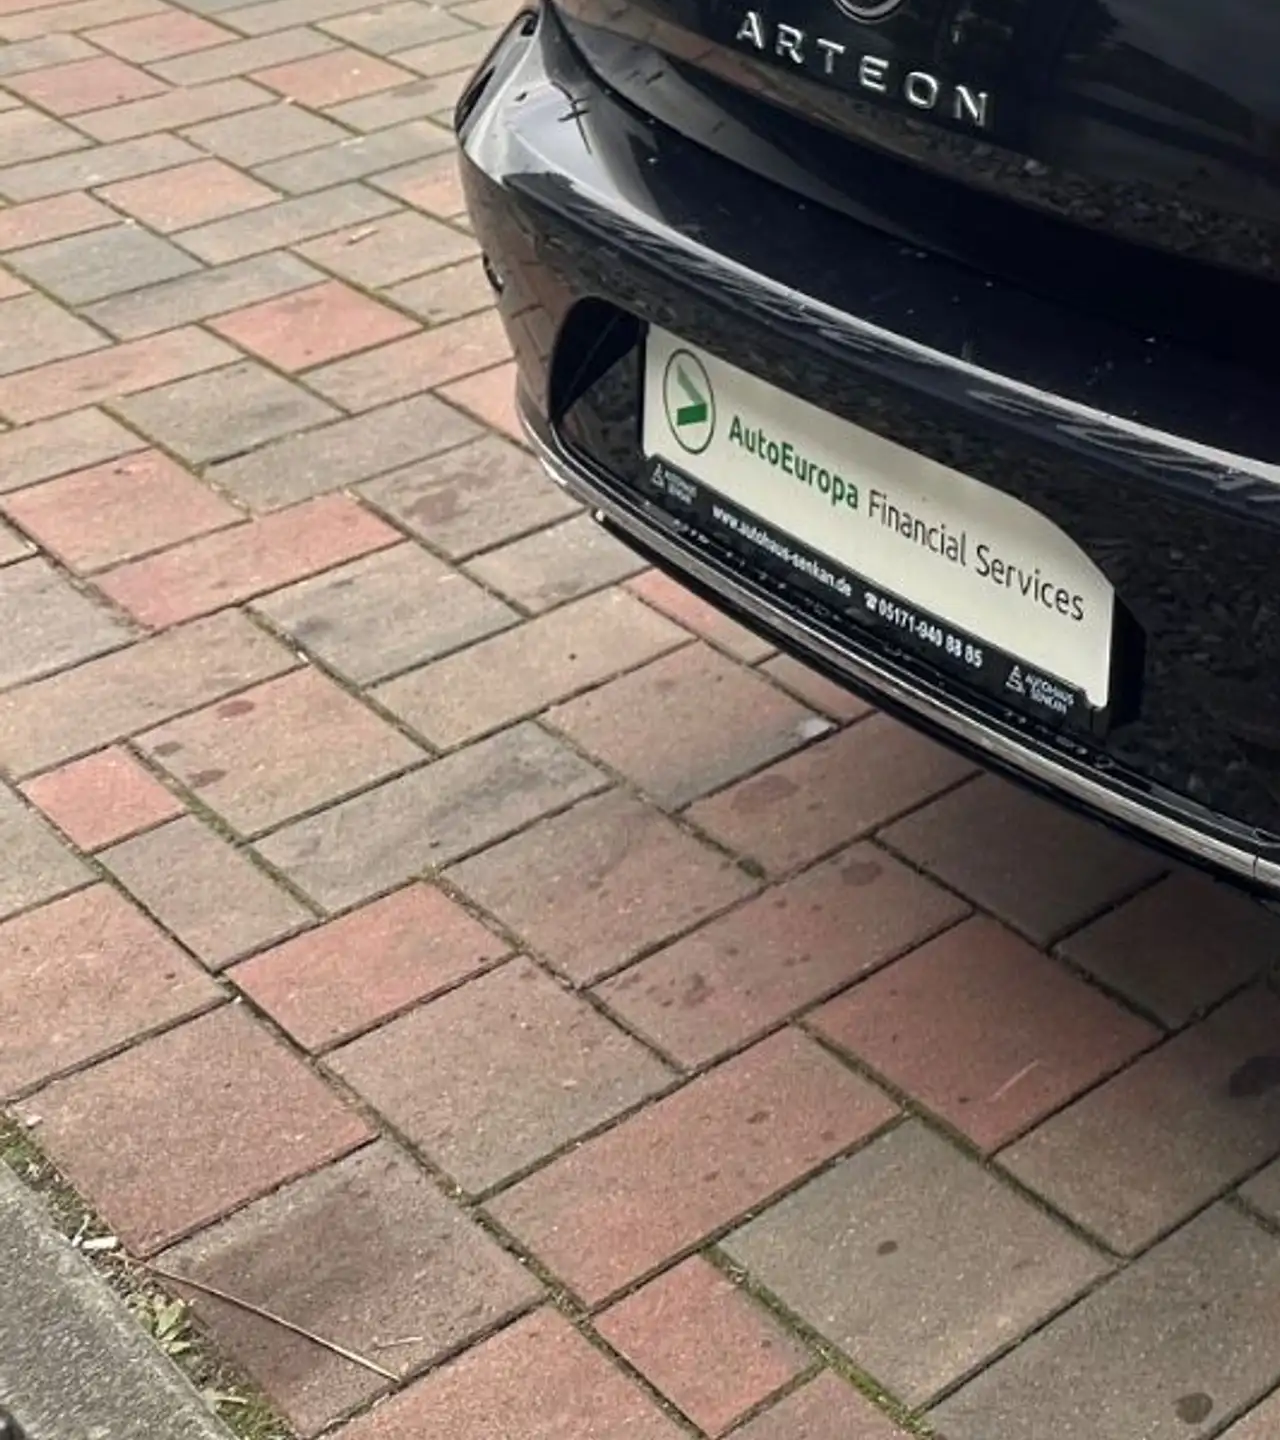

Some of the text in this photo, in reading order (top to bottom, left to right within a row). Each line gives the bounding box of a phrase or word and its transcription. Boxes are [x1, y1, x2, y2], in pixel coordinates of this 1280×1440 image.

[736, 11, 988, 127] ARTEON
[728, 414, 1086, 623] AutoEuropa Financial Services
